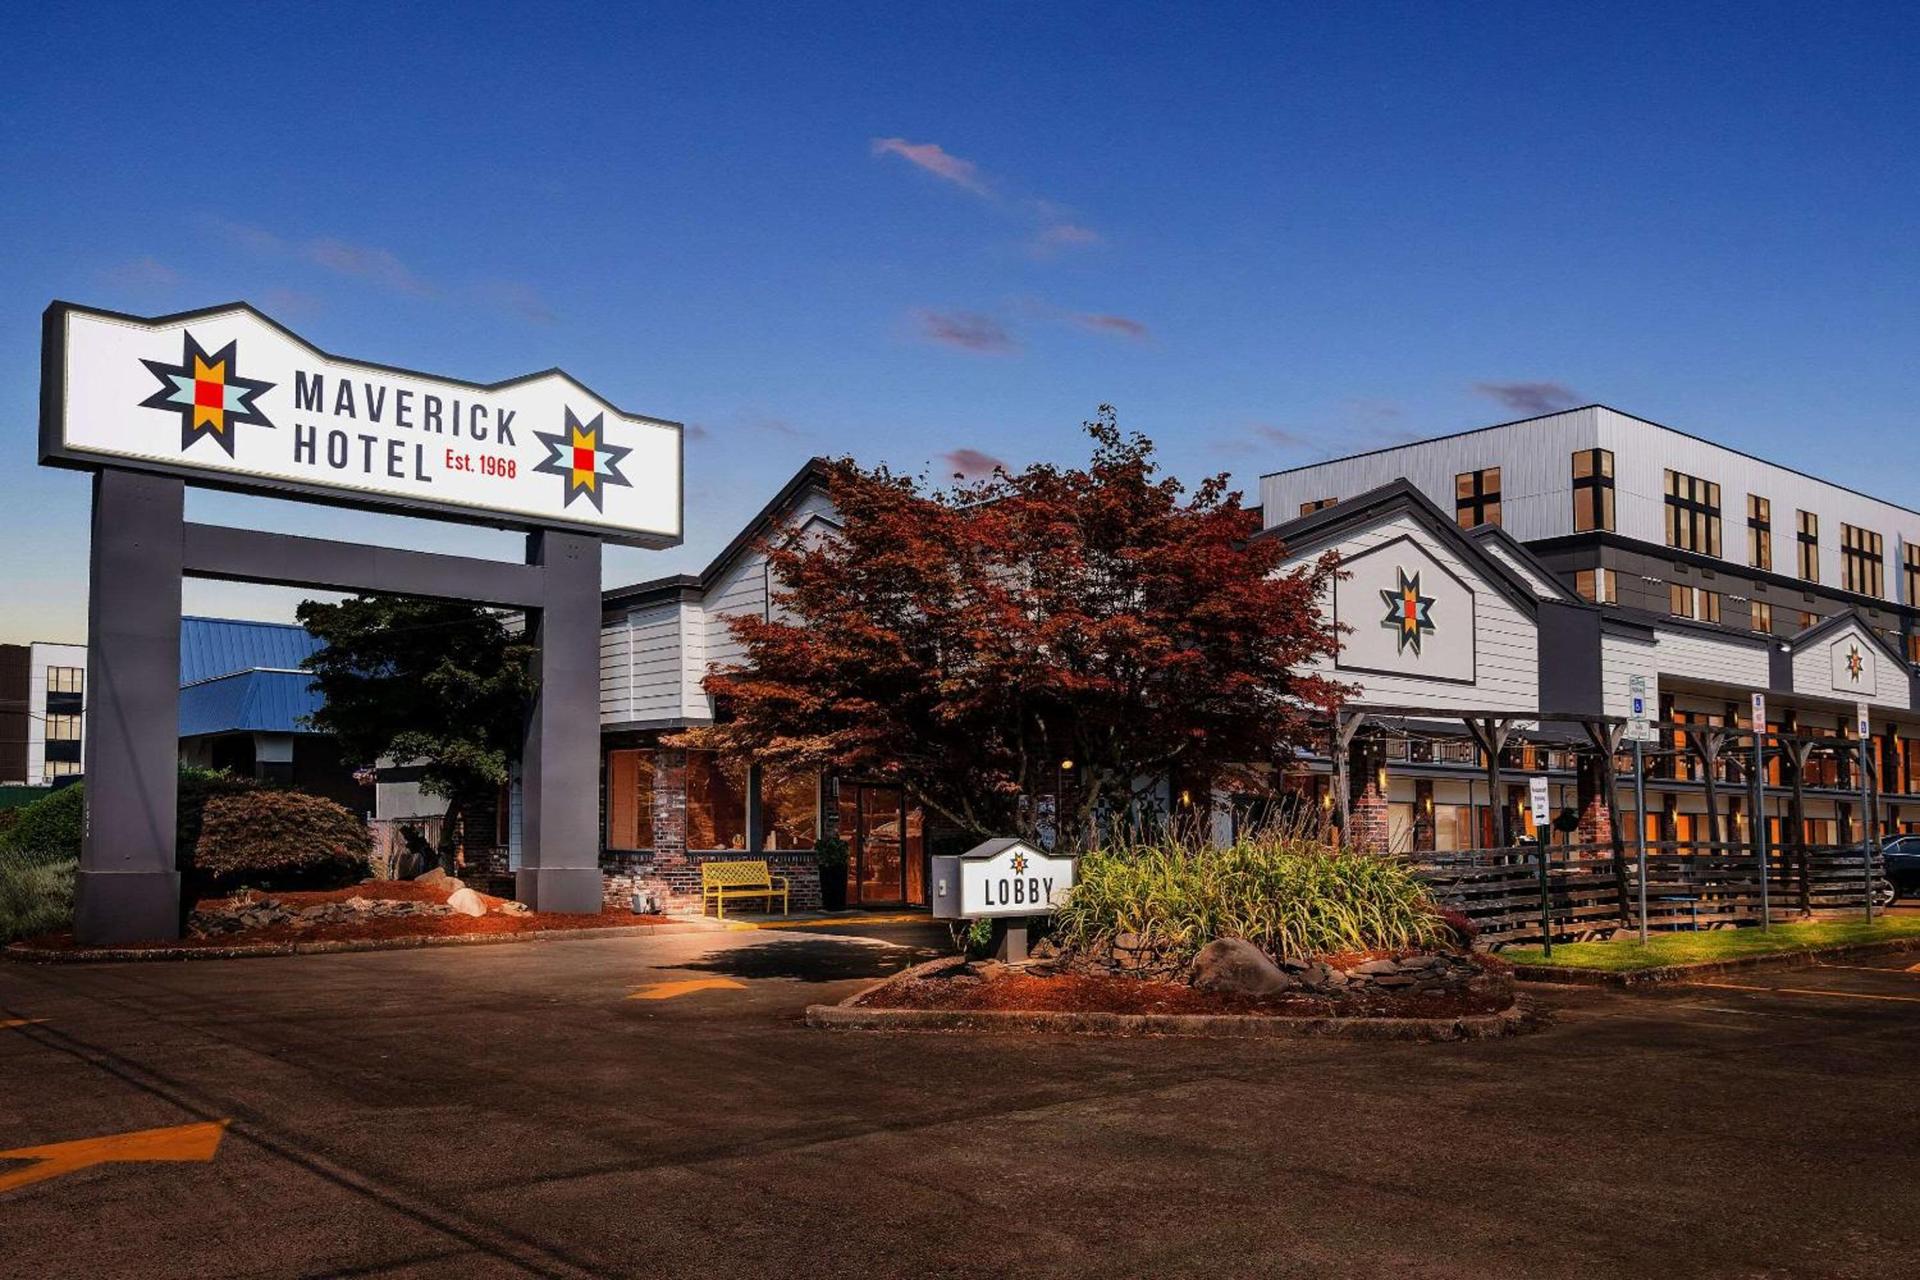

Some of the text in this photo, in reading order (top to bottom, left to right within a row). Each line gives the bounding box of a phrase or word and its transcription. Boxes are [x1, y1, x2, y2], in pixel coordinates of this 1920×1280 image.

[295, 370, 516, 446] MAVERICK
[294, 423, 432, 483] HOTEL
[446, 448, 516, 479] Est. 1968
[985, 877, 1053, 906] LOBBY
